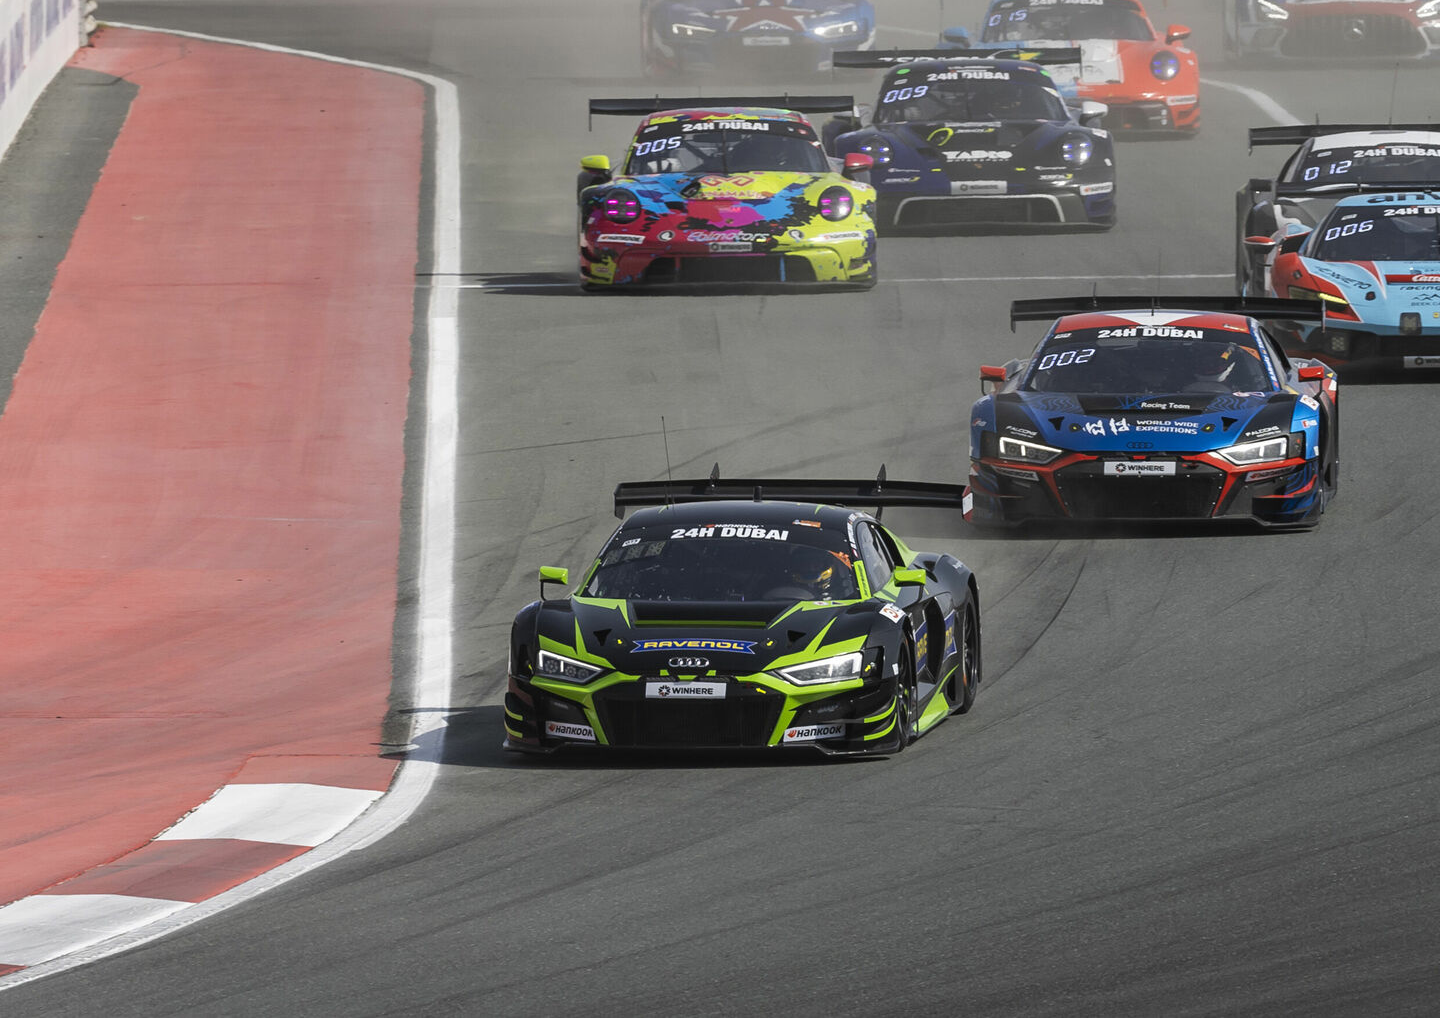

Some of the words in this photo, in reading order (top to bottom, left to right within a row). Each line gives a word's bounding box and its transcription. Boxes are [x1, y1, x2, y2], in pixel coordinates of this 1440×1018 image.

[927, 73, 958, 81] 24H
[962, 72, 1010, 80] DUBAI
[883, 85, 928, 103] 009
[682, 122, 714, 132] 24H
[719, 122, 769, 131] DUBAI
[636, 136, 682, 156] 005
[1354, 149, 1387, 158] 24H
[1304, 160, 1352, 181] 012
[1384, 207, 1419, 217] 24H
[1324, 220, 1374, 241] 006
[1098, 329, 1136, 339] 24H
[1142, 329, 1204, 339] DUBAI
[1038, 348, 1096, 370] 002
[1141, 402, 1167, 410] Racing
[1168, 402, 1190, 410] Team
[1135, 426, 1198, 435] EXPEDITIONS
[670, 528, 715, 540] 24H
[720, 528, 789, 541] DUBAI
[643, 640, 746, 651] RAVENOL
[671, 687, 714, 695] WINHERE
